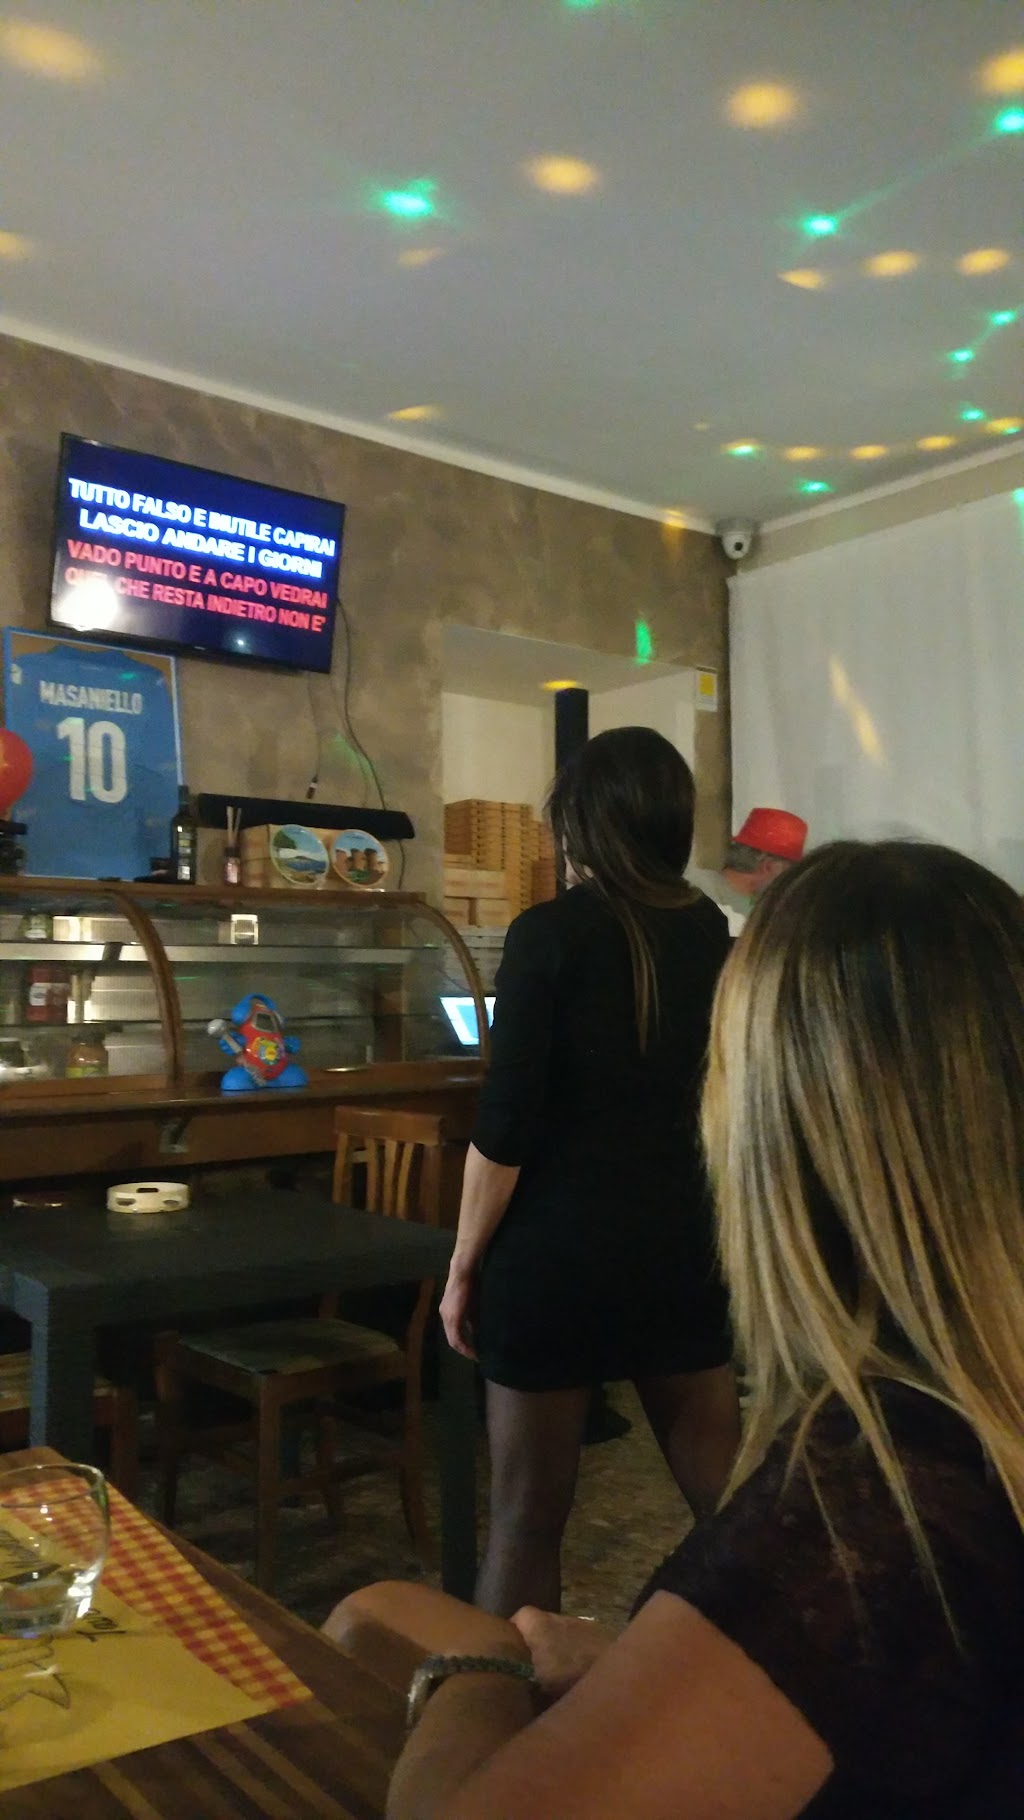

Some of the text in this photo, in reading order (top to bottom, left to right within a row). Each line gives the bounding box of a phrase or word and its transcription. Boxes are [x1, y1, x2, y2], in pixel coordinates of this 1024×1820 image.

[68, 477, 336, 557] TUTTO FALSO E INUTILE CAPIRAI
[79, 508, 323, 579] LASCIO ANDARE I GIORNI
[67, 539, 122, 567] VADO
[124, 551, 187, 580] PUNTO
[188, 564, 202, 584] E
[203, 568, 218, 587] A
[220, 571, 268, 597] CAPO
[270, 581, 328, 609] VEDRAI
[115, 576, 150, 599] CHE
[152, 583, 205, 609] RESTA
[207, 594, 277, 623] INDIETRO
[278, 608, 310, 630] NON
[39, 680, 143, 715] MASANIELLO
[56, 716, 127, 803] 10
